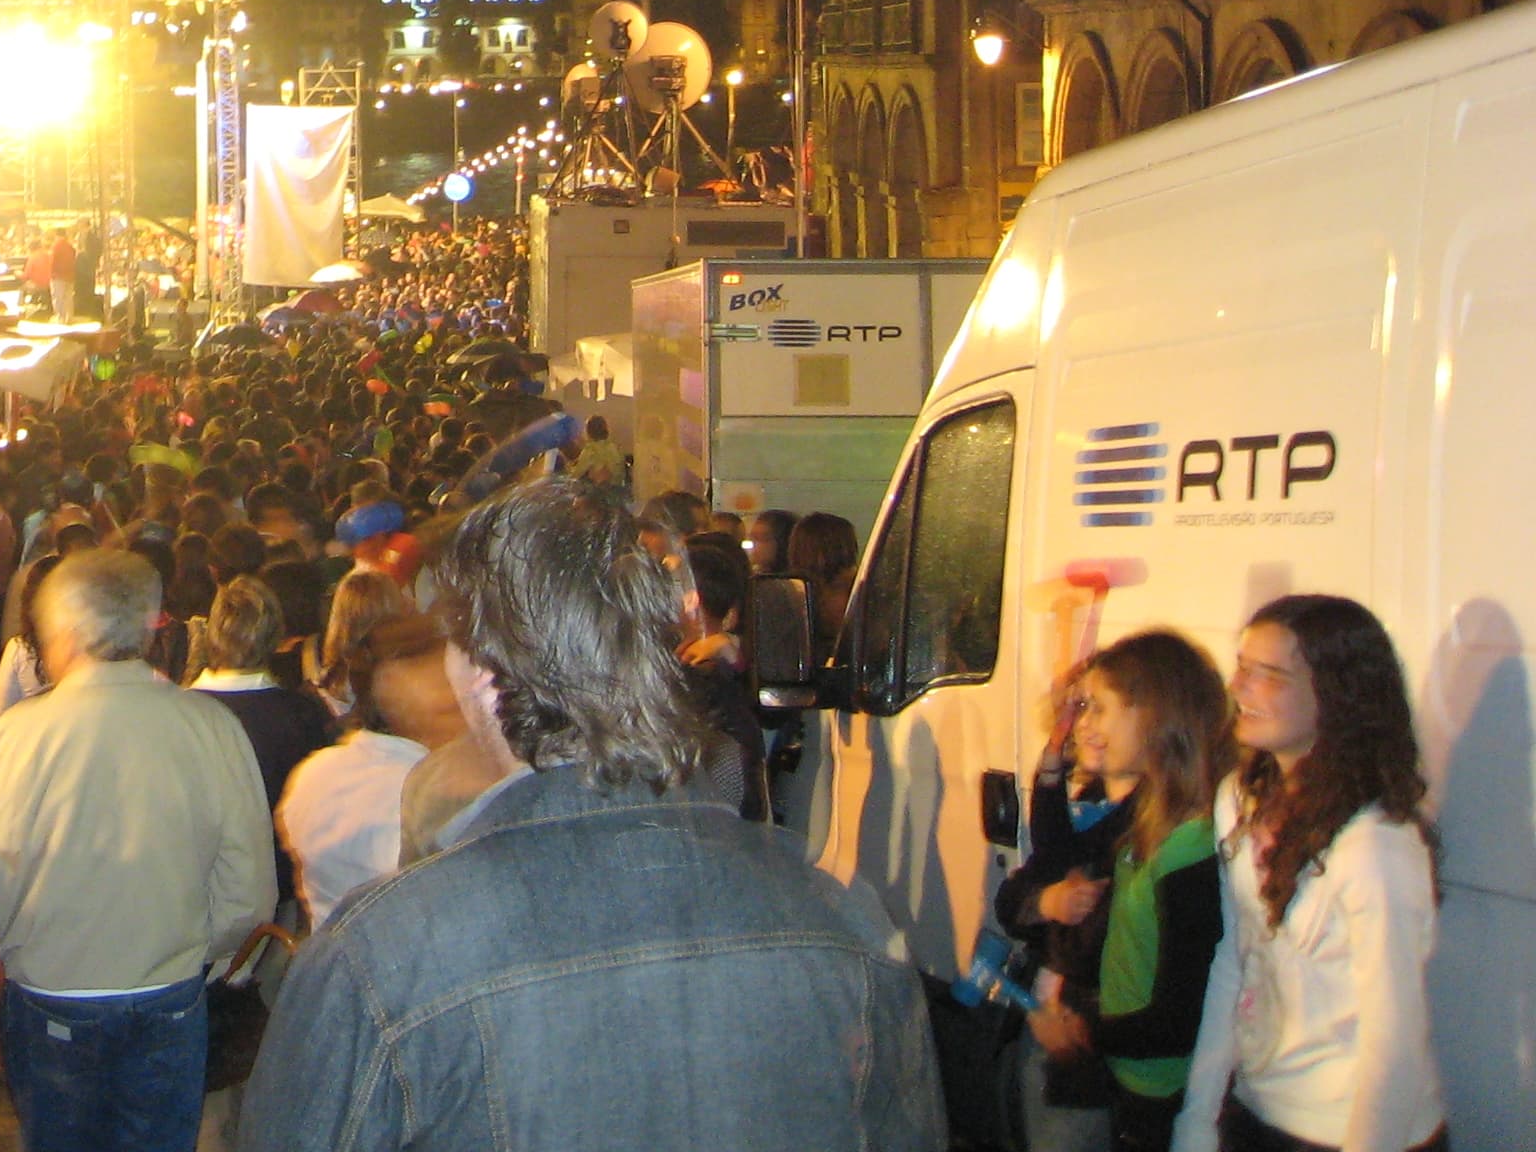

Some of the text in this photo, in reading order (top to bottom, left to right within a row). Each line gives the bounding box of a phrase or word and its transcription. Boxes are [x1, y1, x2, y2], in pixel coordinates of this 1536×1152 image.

[729, 284, 784, 311] BOX
[827, 325, 902, 342] RTP
[1175, 430, 1336, 503] RTP
